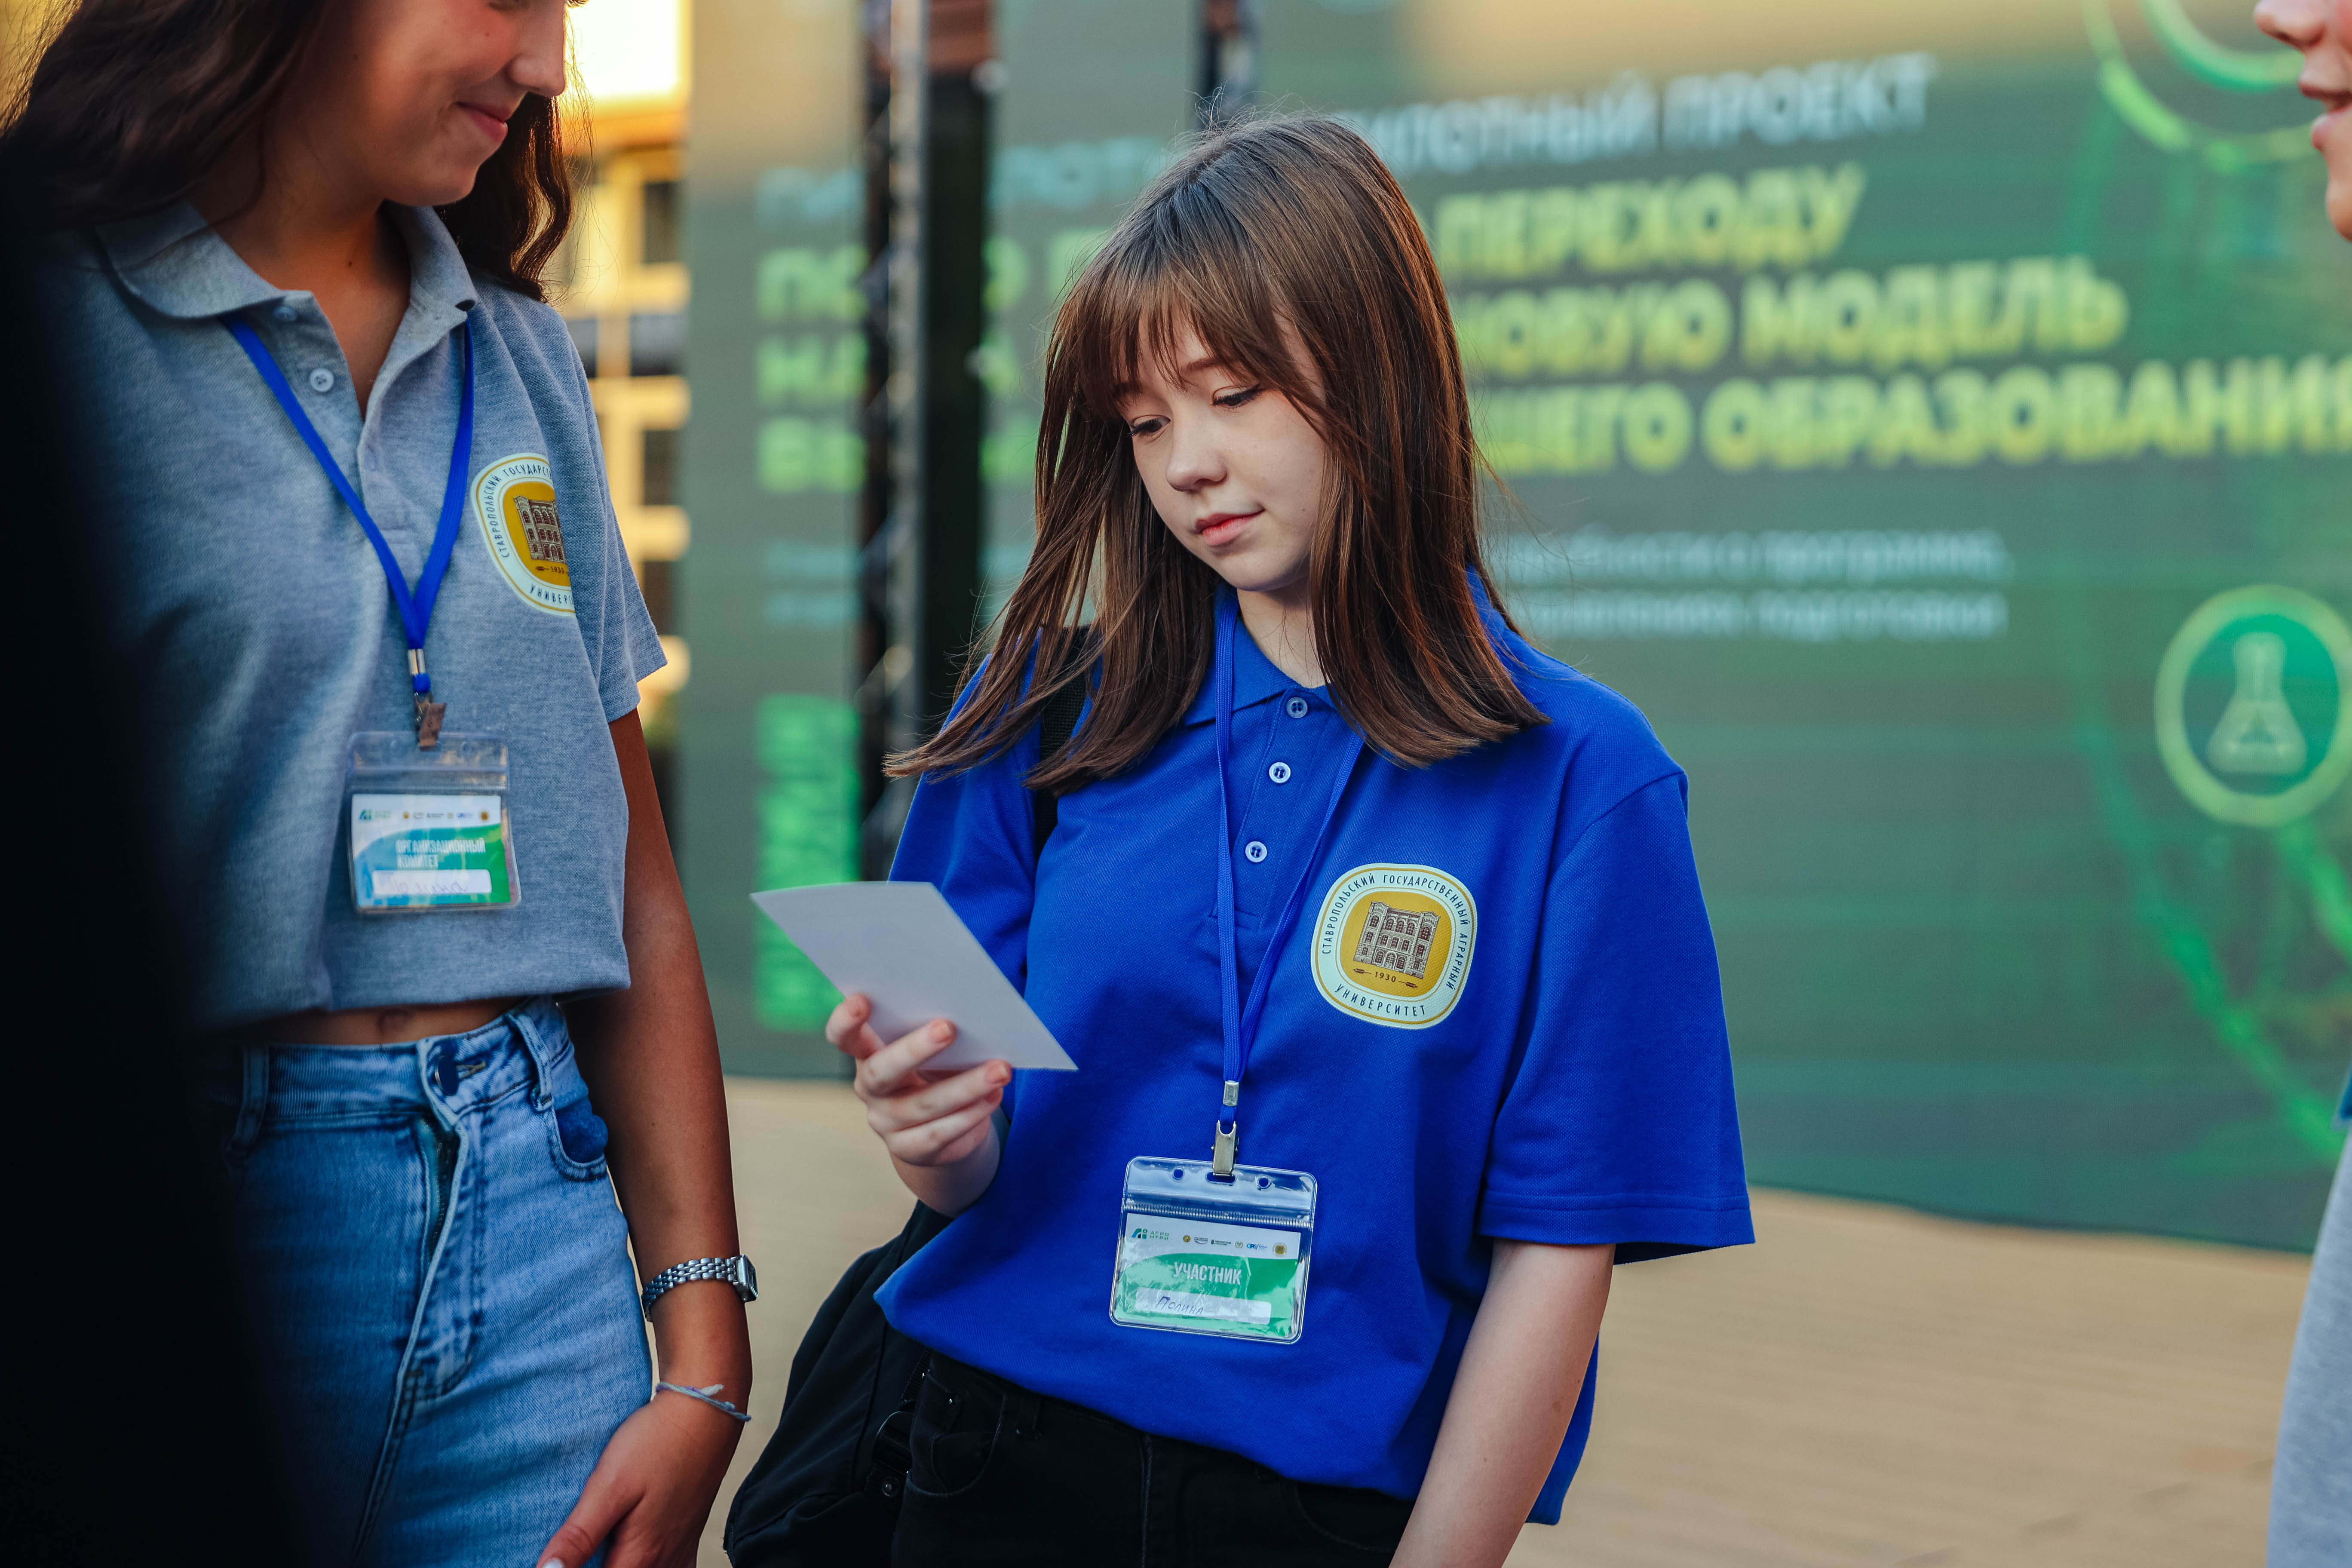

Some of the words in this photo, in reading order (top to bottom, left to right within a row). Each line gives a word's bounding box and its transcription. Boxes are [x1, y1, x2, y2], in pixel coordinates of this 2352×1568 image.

[1665, 52, 1937, 151] ПРОЕКТ
[1434, 161, 1867, 280] ПЕРЕХОДУ
[1743, 256, 2128, 372] МОДЕЛЬ
[483, 474, 510, 558] СТАВРОПОЛЬСКИЙ
[551, 566, 565, 574] 1930
[1322, 873, 1375, 954] СТАВРОПОЛЬСКИЙ
[1383, 875, 1469, 925] ГОСУДАРСТВЕННЫЙ
[1446, 933, 1467, 990] АГРАРНЫЙ
[1334, 983, 1425, 1016] УНИВЕРСИТЕТ
[1375, 971, 1396, 982] 1930
[1173, 1262, 1242, 1285] УЧАСТНИК
[1155, 1295, 1204, 1315] Полина
